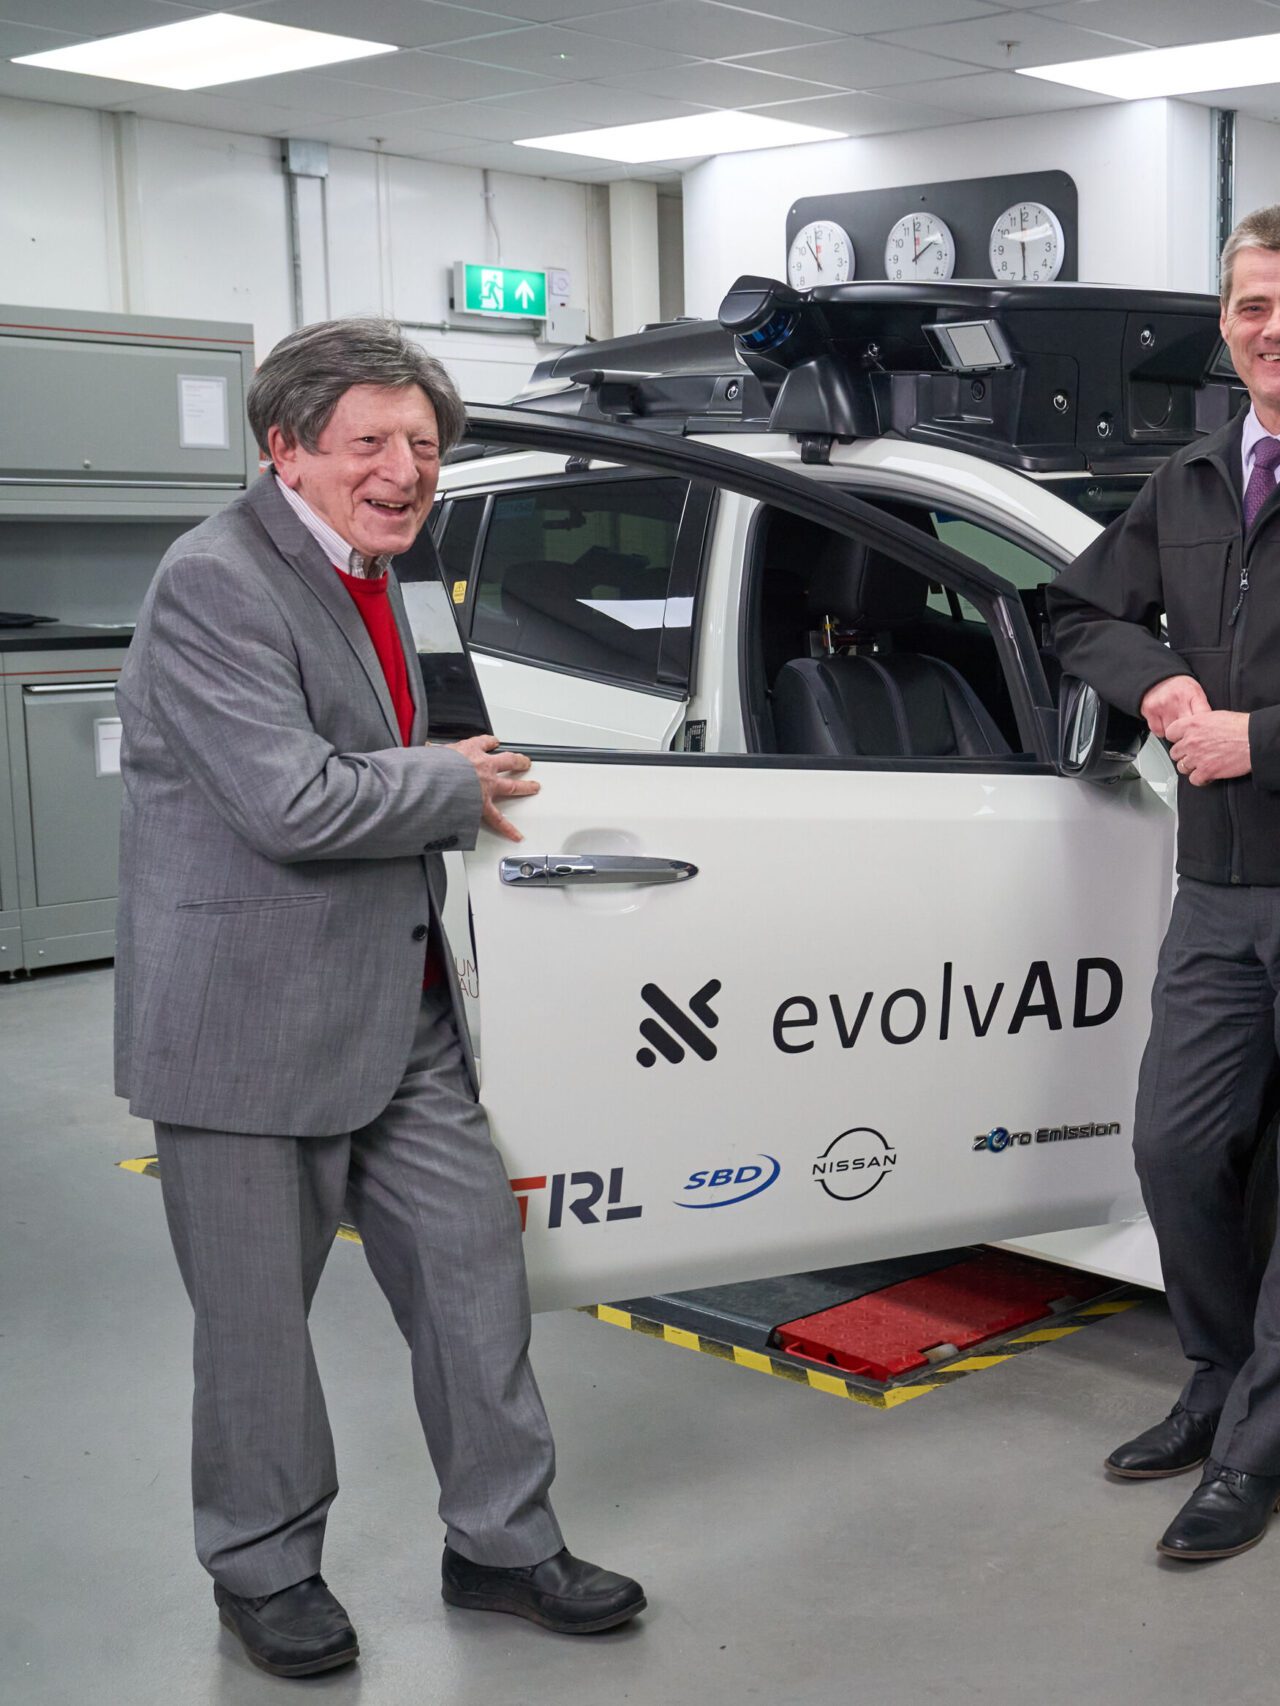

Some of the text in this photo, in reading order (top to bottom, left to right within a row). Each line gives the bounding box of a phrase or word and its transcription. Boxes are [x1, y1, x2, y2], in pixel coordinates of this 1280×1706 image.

[1010, 216, 1016, 227] 11
[904, 227, 910, 237] 11
[895, 238, 904, 248] 10
[1045, 242, 1052, 253] 3
[936, 250, 943, 261] 3
[998, 245, 1005, 256] 9
[892, 254, 899, 265] 9
[1001, 261, 1008, 271] 8
[772, 956, 1124, 1054] evolvAD
[1034, 1121, 1121, 1143] Emission
[812, 1153, 897, 1176] NISSAN
[683, 1165, 762, 1190] SBD
[509, 1166, 643, 1233] TRL
